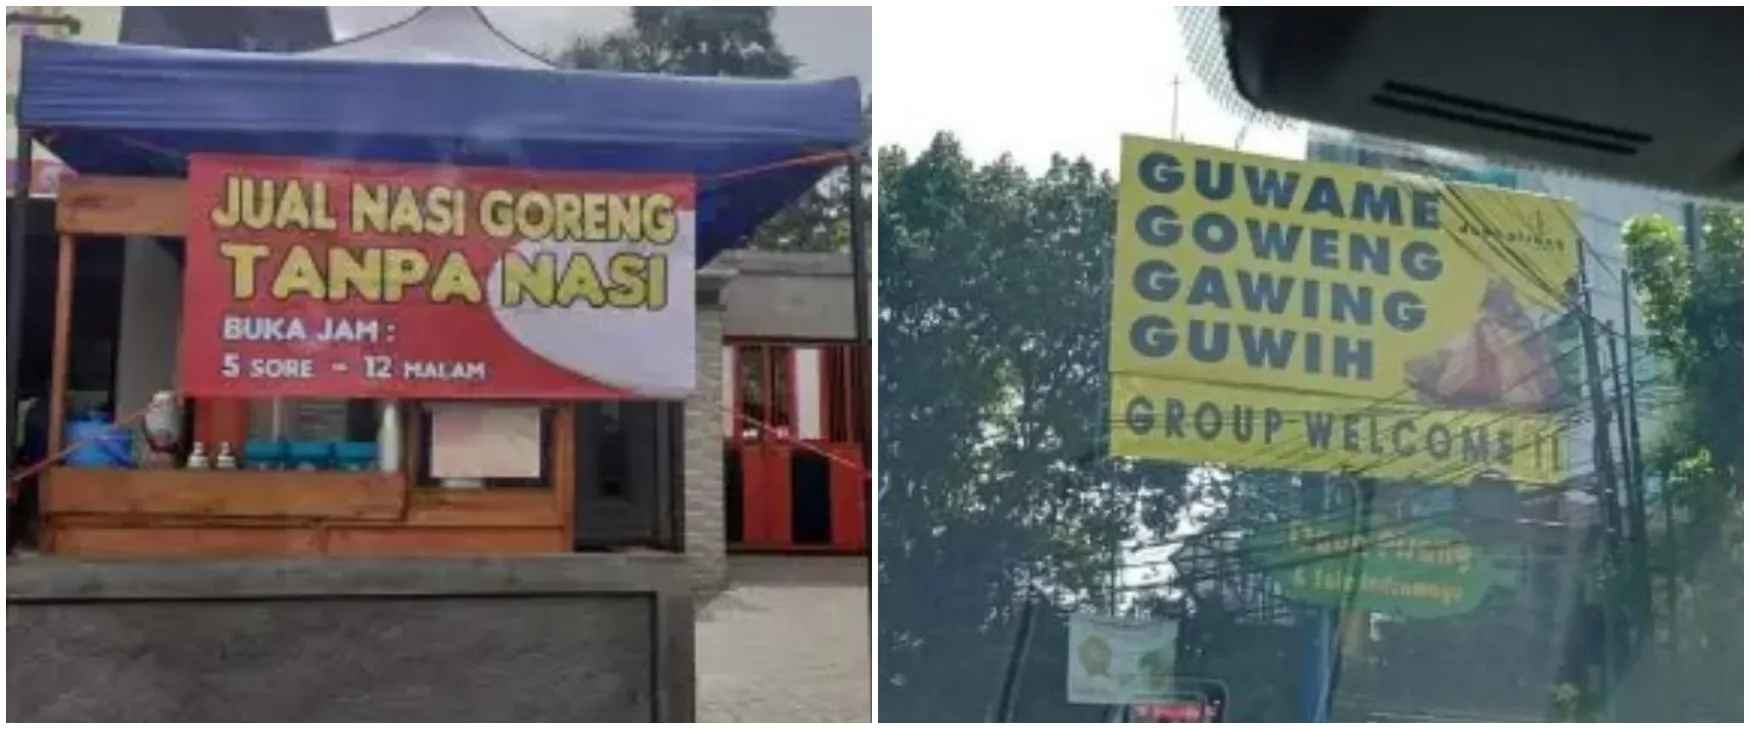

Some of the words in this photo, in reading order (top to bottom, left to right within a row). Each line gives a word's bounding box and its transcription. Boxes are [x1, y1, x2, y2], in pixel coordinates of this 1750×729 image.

[211, 176, 336, 230] JUAL
[352, 183, 466, 235] NASI
[480, 190, 676, 243] GORENG
[1138, 153, 1442, 229] GUWAME
[221, 244, 482, 303] TANPA
[502, 251, 668, 309] NASI
[1135, 205, 1444, 281] GOWENG
[223, 316, 307, 341] BUKA
[317, 319, 378, 343] JAM
[1132, 260, 1427, 332] GAWING
[222, 353, 241, 377] 5
[250, 358, 315, 378] SORE
[363, 356, 392, 377] 12
[404, 361, 486, 380] MALAM
[1129, 314, 1374, 381] GUWIH
[1125, 395, 1284, 445] GROUP
[1305, 411, 1513, 466] WELCOME
